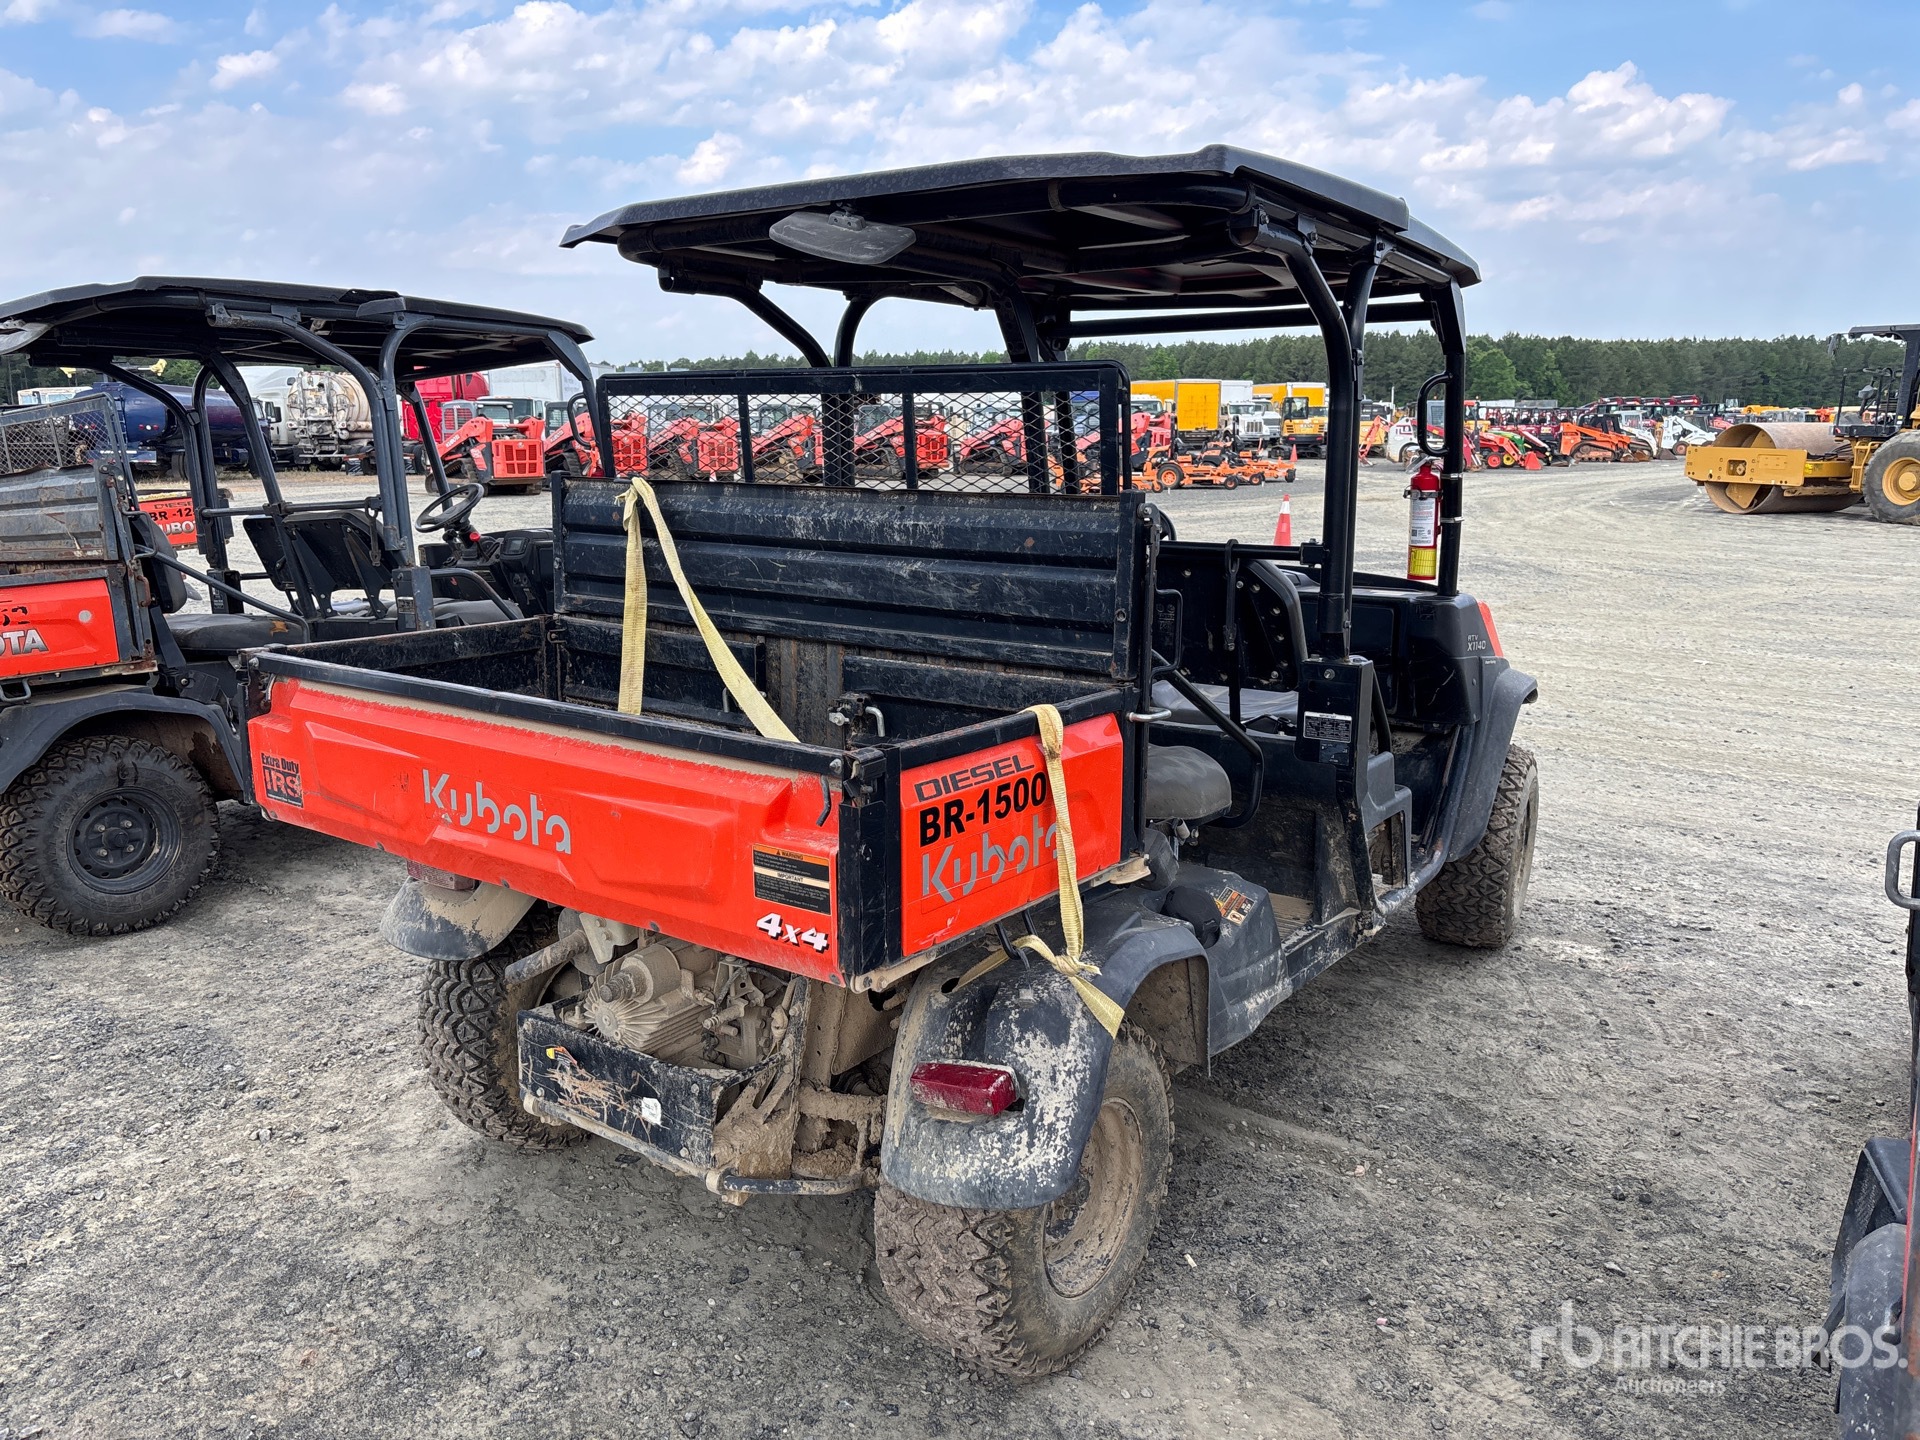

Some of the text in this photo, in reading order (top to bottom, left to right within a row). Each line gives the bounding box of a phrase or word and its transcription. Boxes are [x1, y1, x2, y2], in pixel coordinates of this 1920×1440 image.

[0, 629, 49, 656] TA
[1467, 641, 1486, 651] X1140
[261, 752, 299, 774] Extra Duty
[264, 769, 301, 799] IRS
[914, 754, 1035, 803] DIESEL
[422, 768, 571, 855] Kubota
[919, 771, 1047, 848] BR-1500
[781, 850, 804, 860] WARNING
[777, 872, 804, 882] IMPORTANT
[756, 912, 830, 954] 4x4
